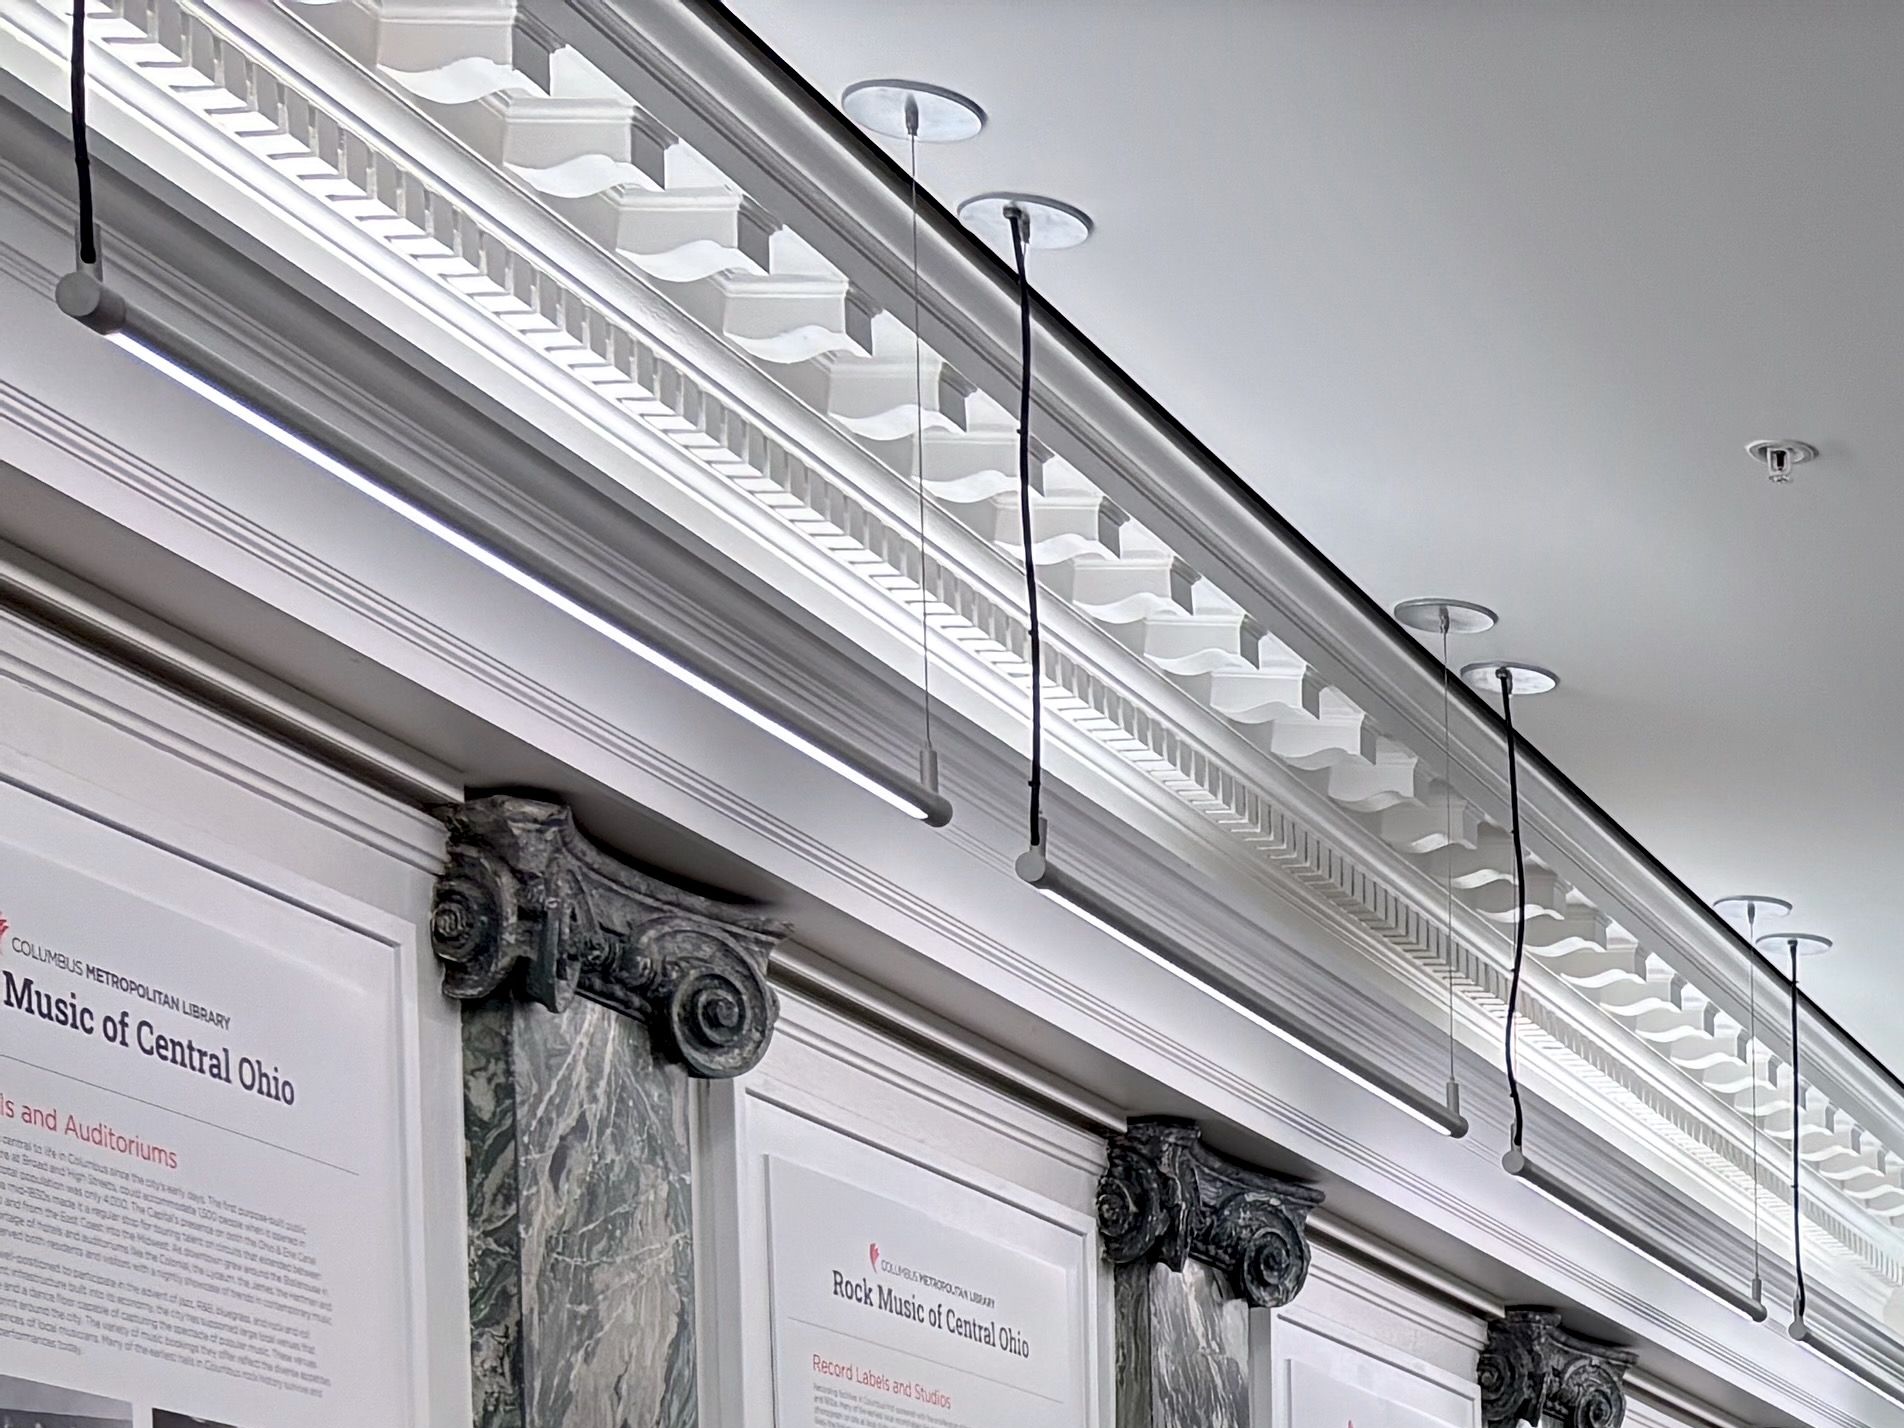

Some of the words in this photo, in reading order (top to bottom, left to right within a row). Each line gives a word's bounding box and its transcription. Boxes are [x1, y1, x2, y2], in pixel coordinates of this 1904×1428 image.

[12, 937, 84, 976] COLUMBUS
[86, 963, 180, 1011] METROPOLITAN
[182, 1003, 230, 1030] LIBRARY
[2, 969, 94, 1035] Music
[103, 1010, 129, 1047] of
[136, 1020, 232, 1084] Central
[238, 1056, 295, 1106] Ohio
[21, 1103, 57, 1132] and
[64, 1115, 178, 1169] Auditoriums
[832, 1269, 873, 1307] Rock
[877, 1284, 925, 1324] Music
[928, 1304, 943, 1329] of
[946, 1309, 996, 1348] Central
[999, 1327, 1030, 1359] Ohio
[881, 1259, 918, 1282] COLUMBUS
[919, 1272, 969, 1299] METROPOLITAN
[970, 1289, 995, 1309] LIBRARY
[812, 1353, 852, 1380] Record
[856, 1366, 890, 1392] Labels
[892, 1380, 912, 1397] and
[914, 1383, 951, 1410] Studios
